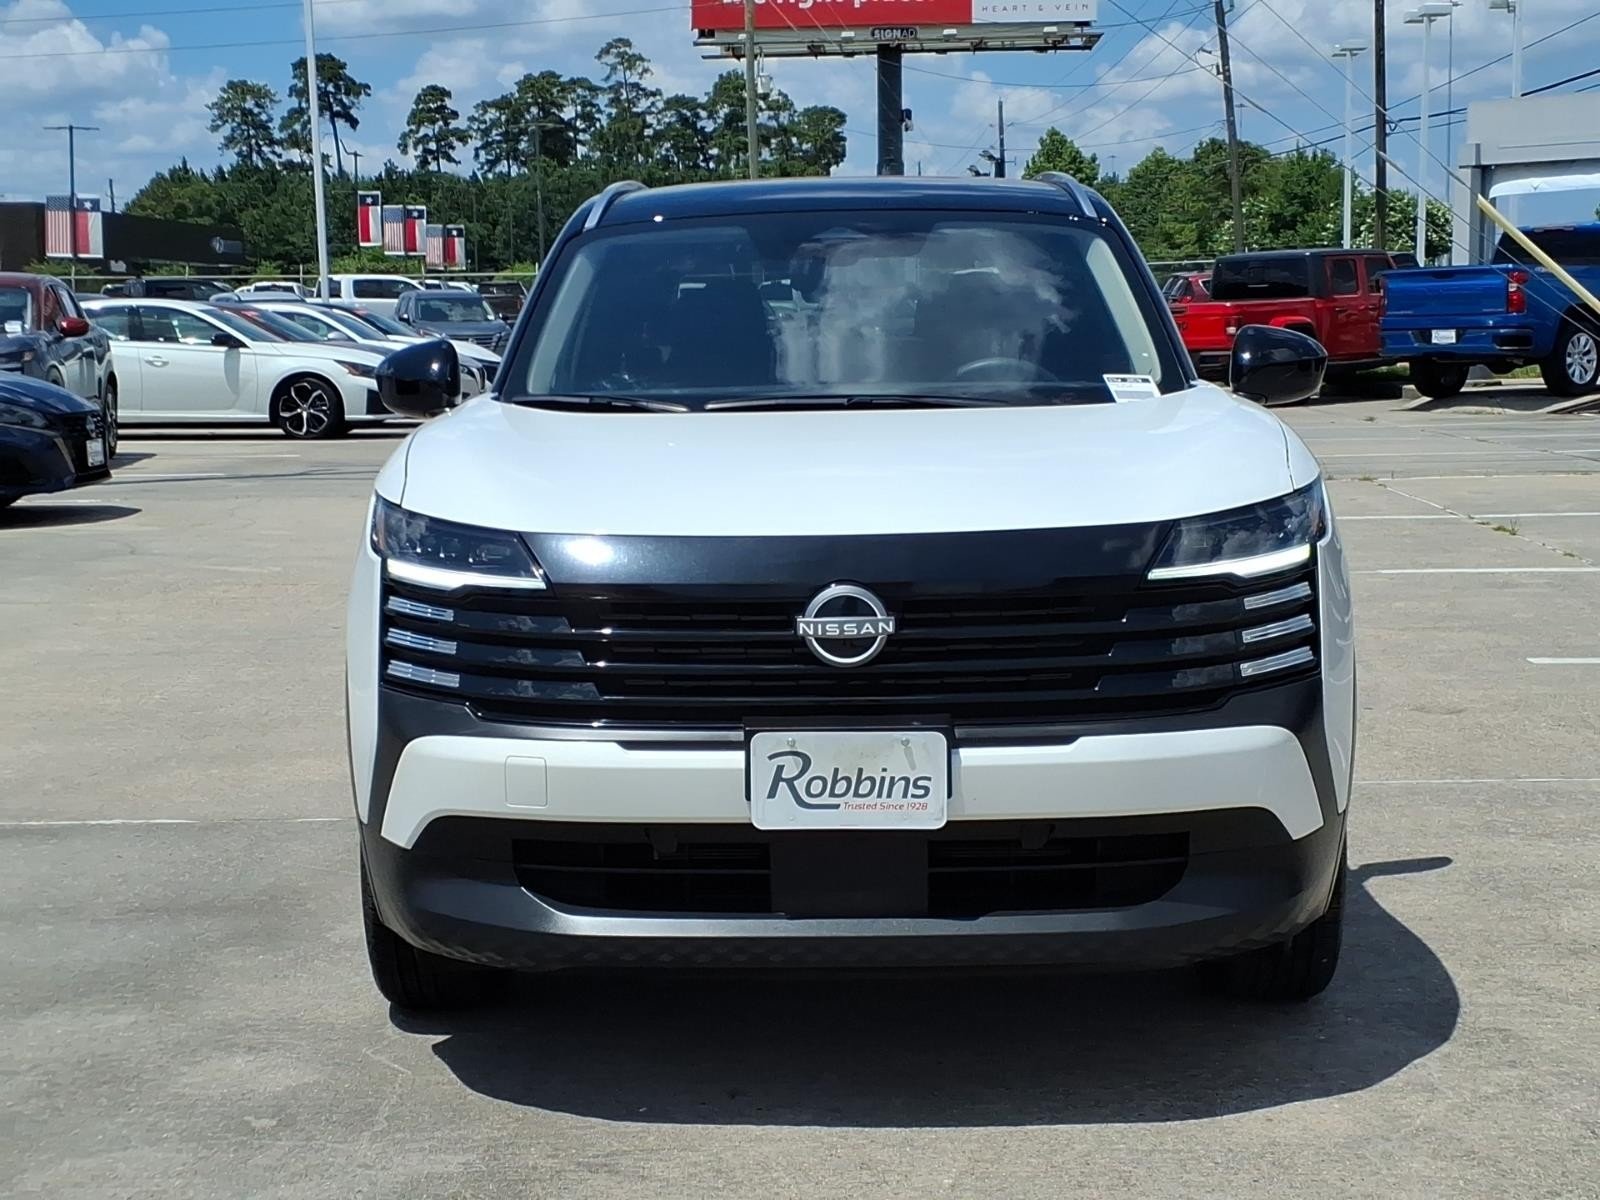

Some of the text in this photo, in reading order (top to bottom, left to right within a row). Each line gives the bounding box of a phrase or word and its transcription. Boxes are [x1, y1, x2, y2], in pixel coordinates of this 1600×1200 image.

[982, 4, 1027, 13] HEART
[1055, 3, 1089, 11] VEIN
[799, 621, 894, 636] NISSAN
[767, 750, 932, 810] Robbins
[843, 802, 928, 811] Trusted Since 1928
